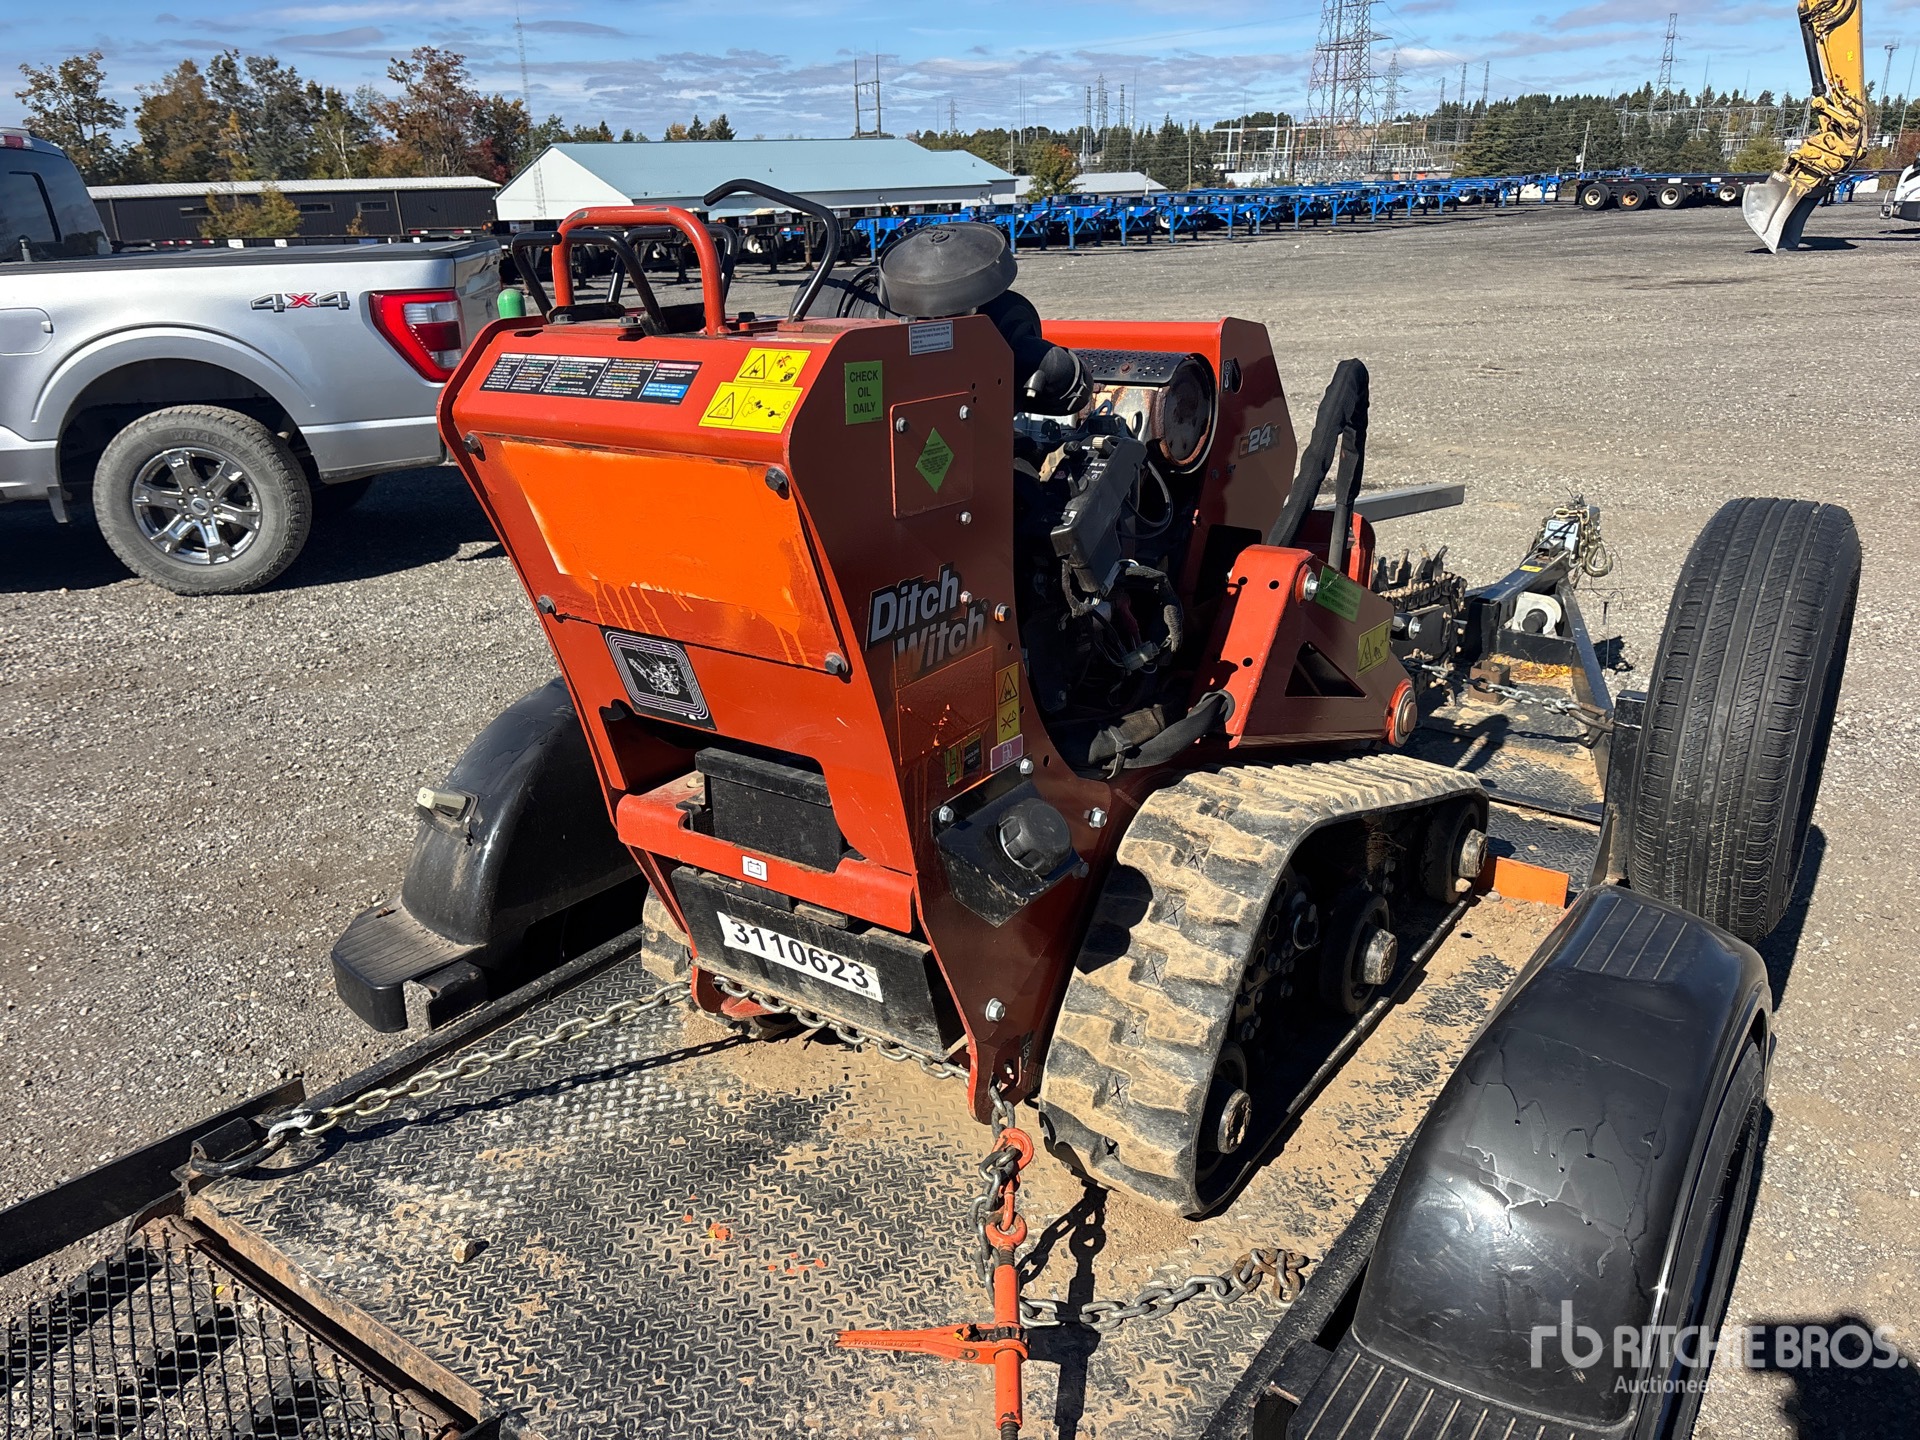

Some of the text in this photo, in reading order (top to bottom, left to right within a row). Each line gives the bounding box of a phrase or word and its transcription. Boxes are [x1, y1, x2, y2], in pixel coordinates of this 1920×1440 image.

[850, 370, 878, 382] CHECK
[857, 386, 871, 398] OIL
[853, 401, 876, 414] DAILY
[170, 429, 261, 471] WRANGLER
[870, 569, 959, 643] Ditch
[896, 606, 985, 668] Witch
[730, 920, 869, 989] 3110623
